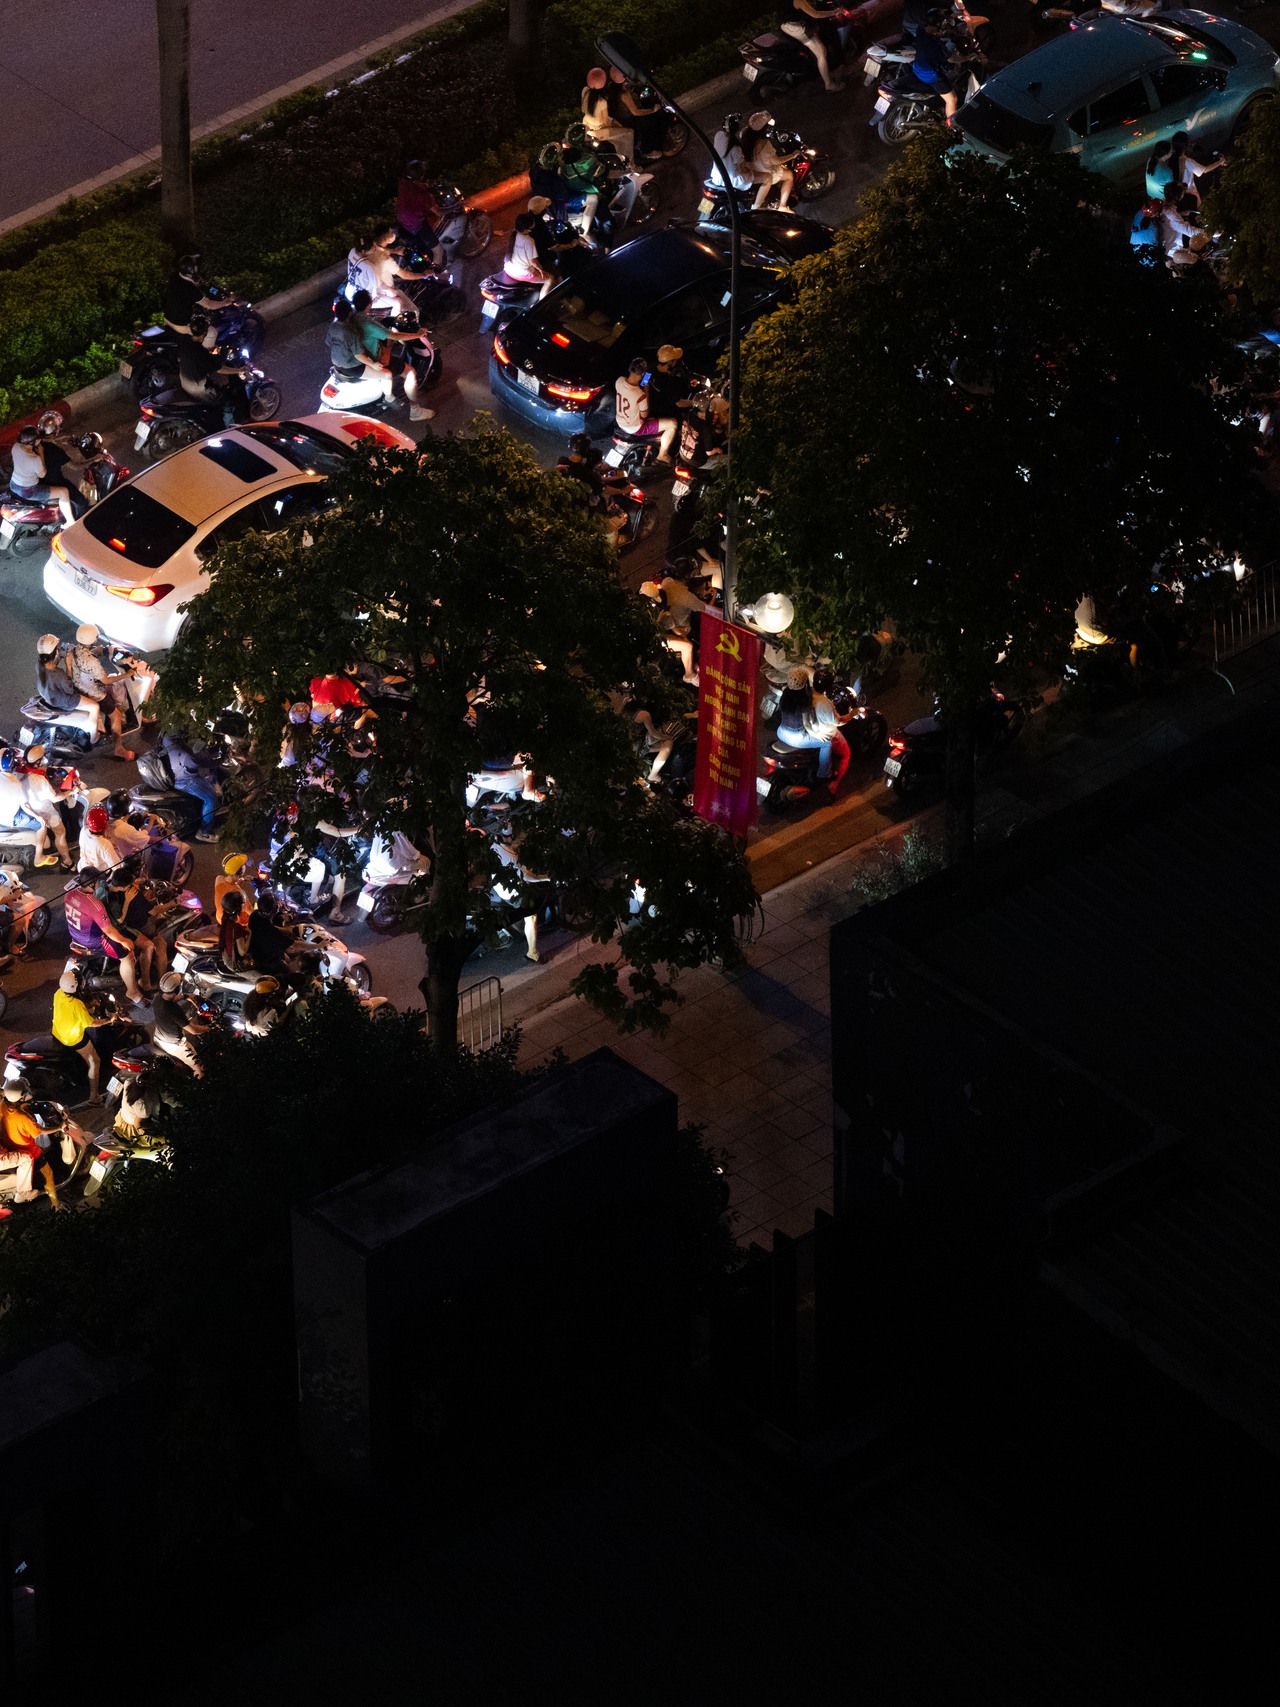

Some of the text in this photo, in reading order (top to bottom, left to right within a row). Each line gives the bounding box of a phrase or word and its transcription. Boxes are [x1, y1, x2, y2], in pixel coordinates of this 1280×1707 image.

[616, 392, 631, 418] 12
[737, 680, 752, 695] SẢN
[725, 691, 740, 705] NAM
[65, 903, 82, 930] 25
